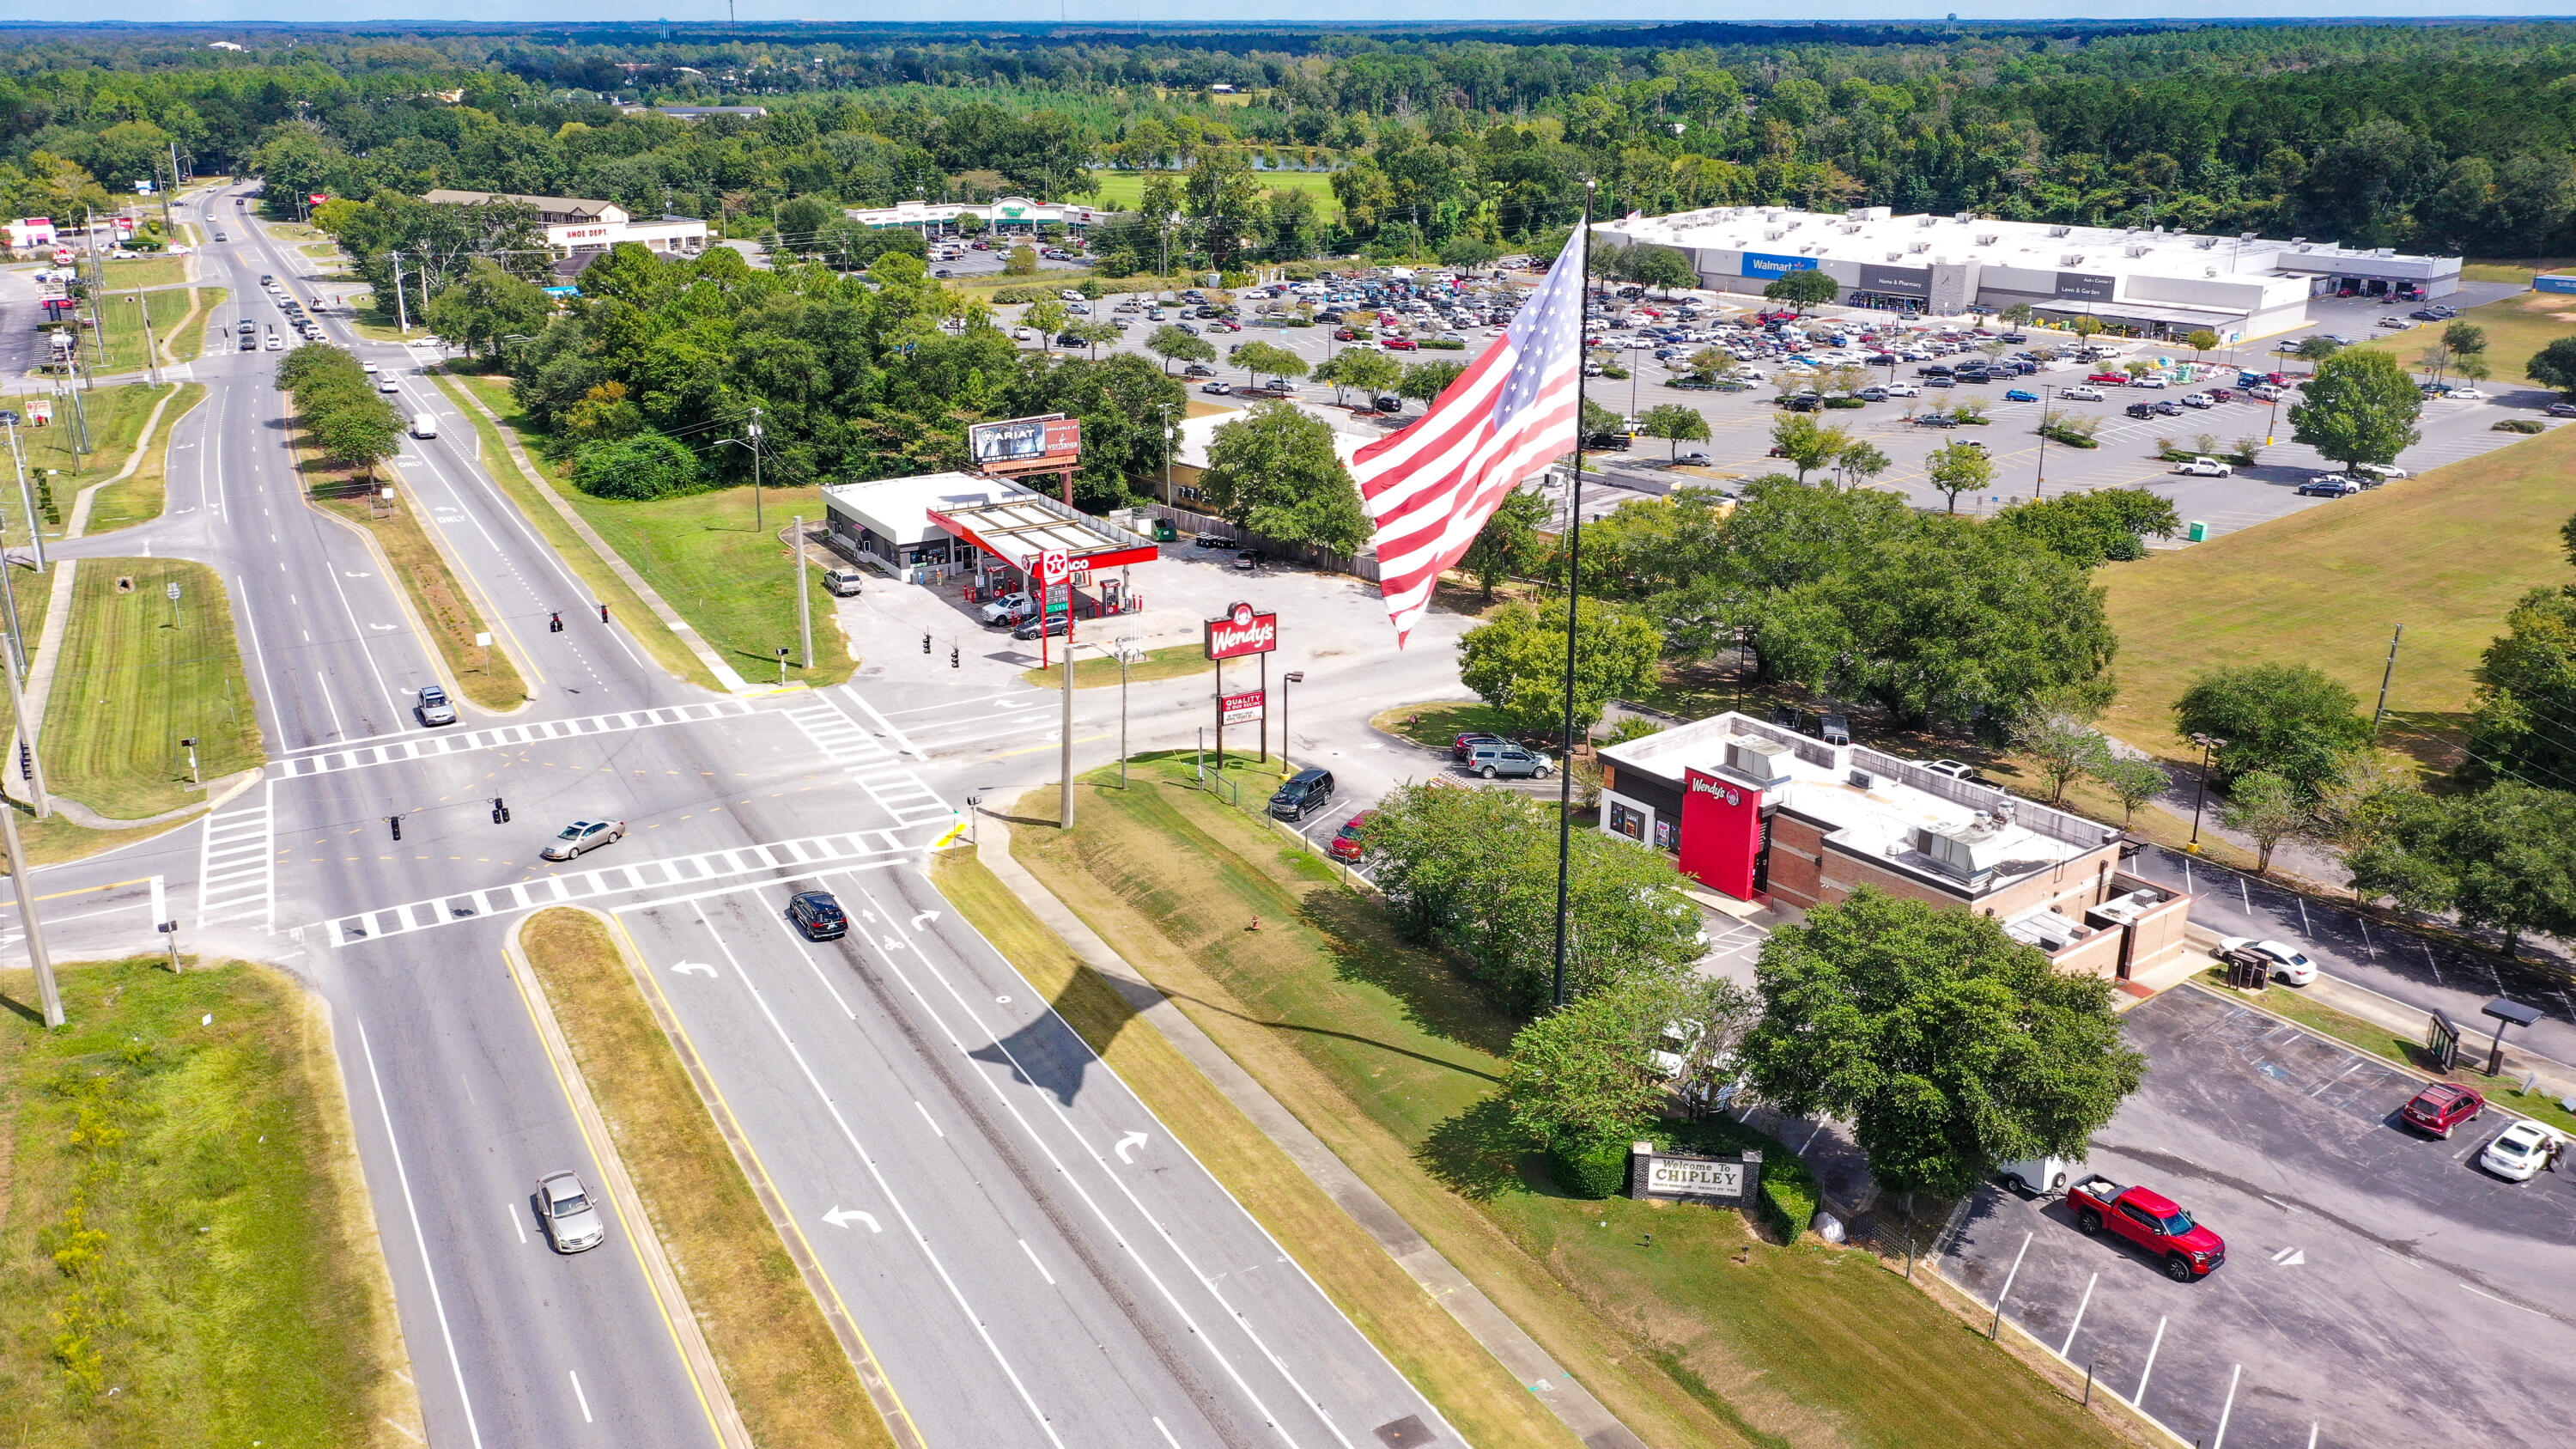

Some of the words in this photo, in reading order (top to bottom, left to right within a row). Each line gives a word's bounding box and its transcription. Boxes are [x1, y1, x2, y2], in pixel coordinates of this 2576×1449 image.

[567, 229, 586, 238] SHOE
[1753, 259, 1792, 271] Walmart
[1899, 280, 1923, 289] Pharmacy
[995, 430, 1036, 441] ARIAT
[437, 514, 466, 524] ONLY
[1212, 620, 1274, 654] Wendy's
[1226, 695, 1261, 706] QUALITY
[1692, 777, 1725, 800] Wendy's
[1662, 1160, 1712, 1171] Welcome
[1718, 1163, 1731, 1172] To
[1656, 1168, 1737, 1185] CHIPLEY
